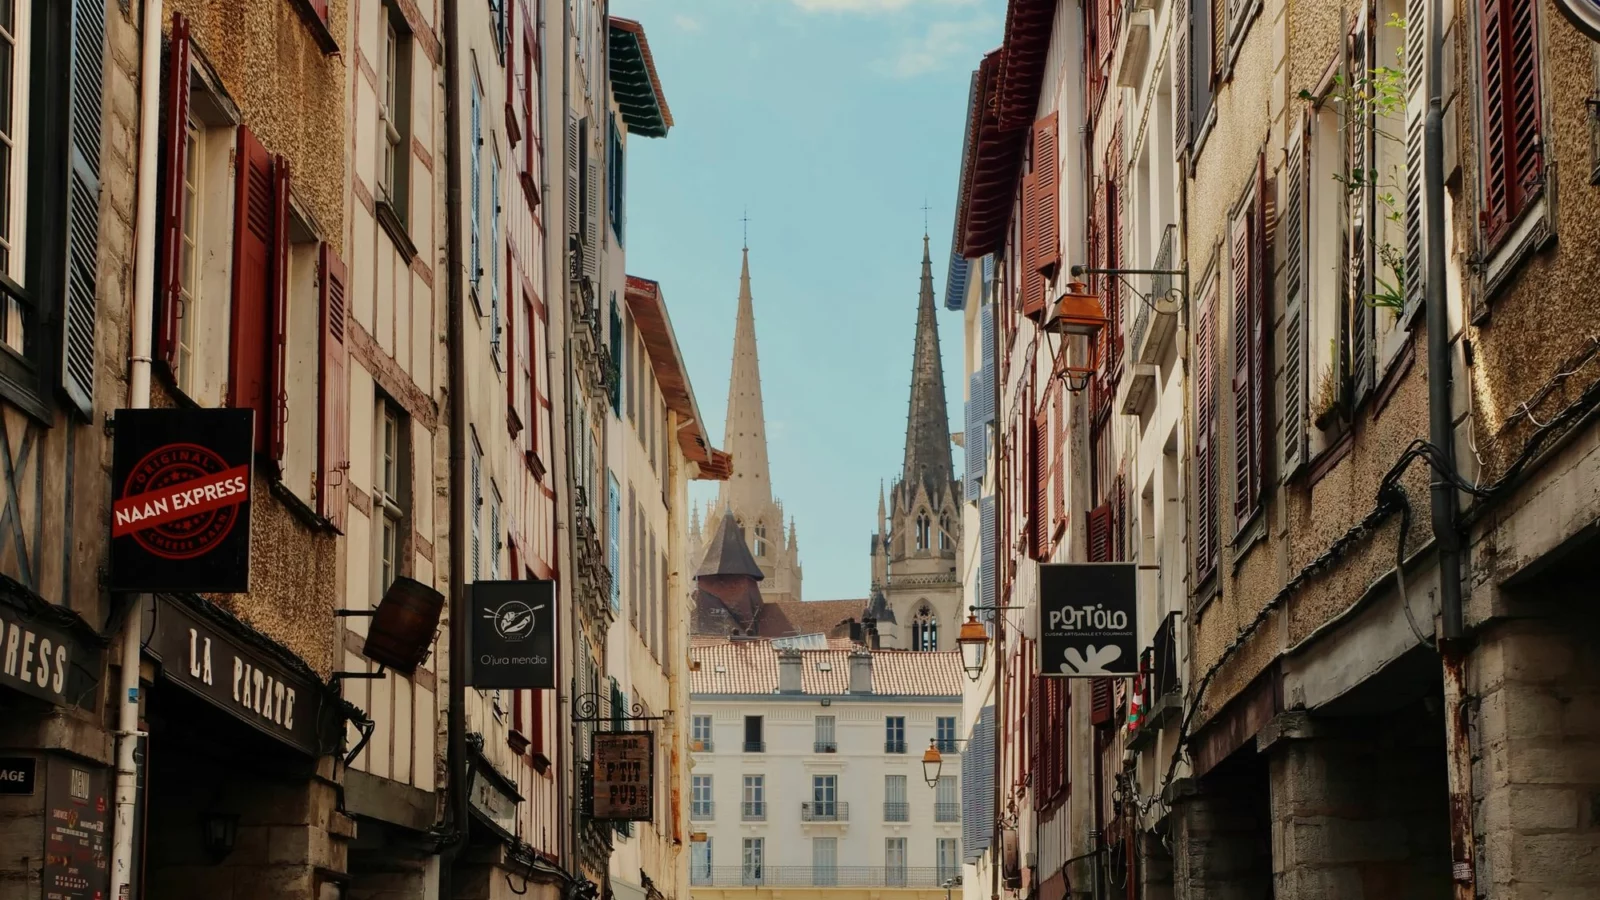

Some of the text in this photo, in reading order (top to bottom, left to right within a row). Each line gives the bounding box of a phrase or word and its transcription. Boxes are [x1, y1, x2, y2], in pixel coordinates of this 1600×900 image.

[136, 451, 209, 483] ORIGINAL
[116, 476, 246, 526] NAAN EXPRESS
[148, 513, 229, 550] CHEESE NAAN
[480, 654, 548, 666] O'jura mendia
[189, 628, 296, 731] LA PATATE
[610, 784, 637, 805] PUB
